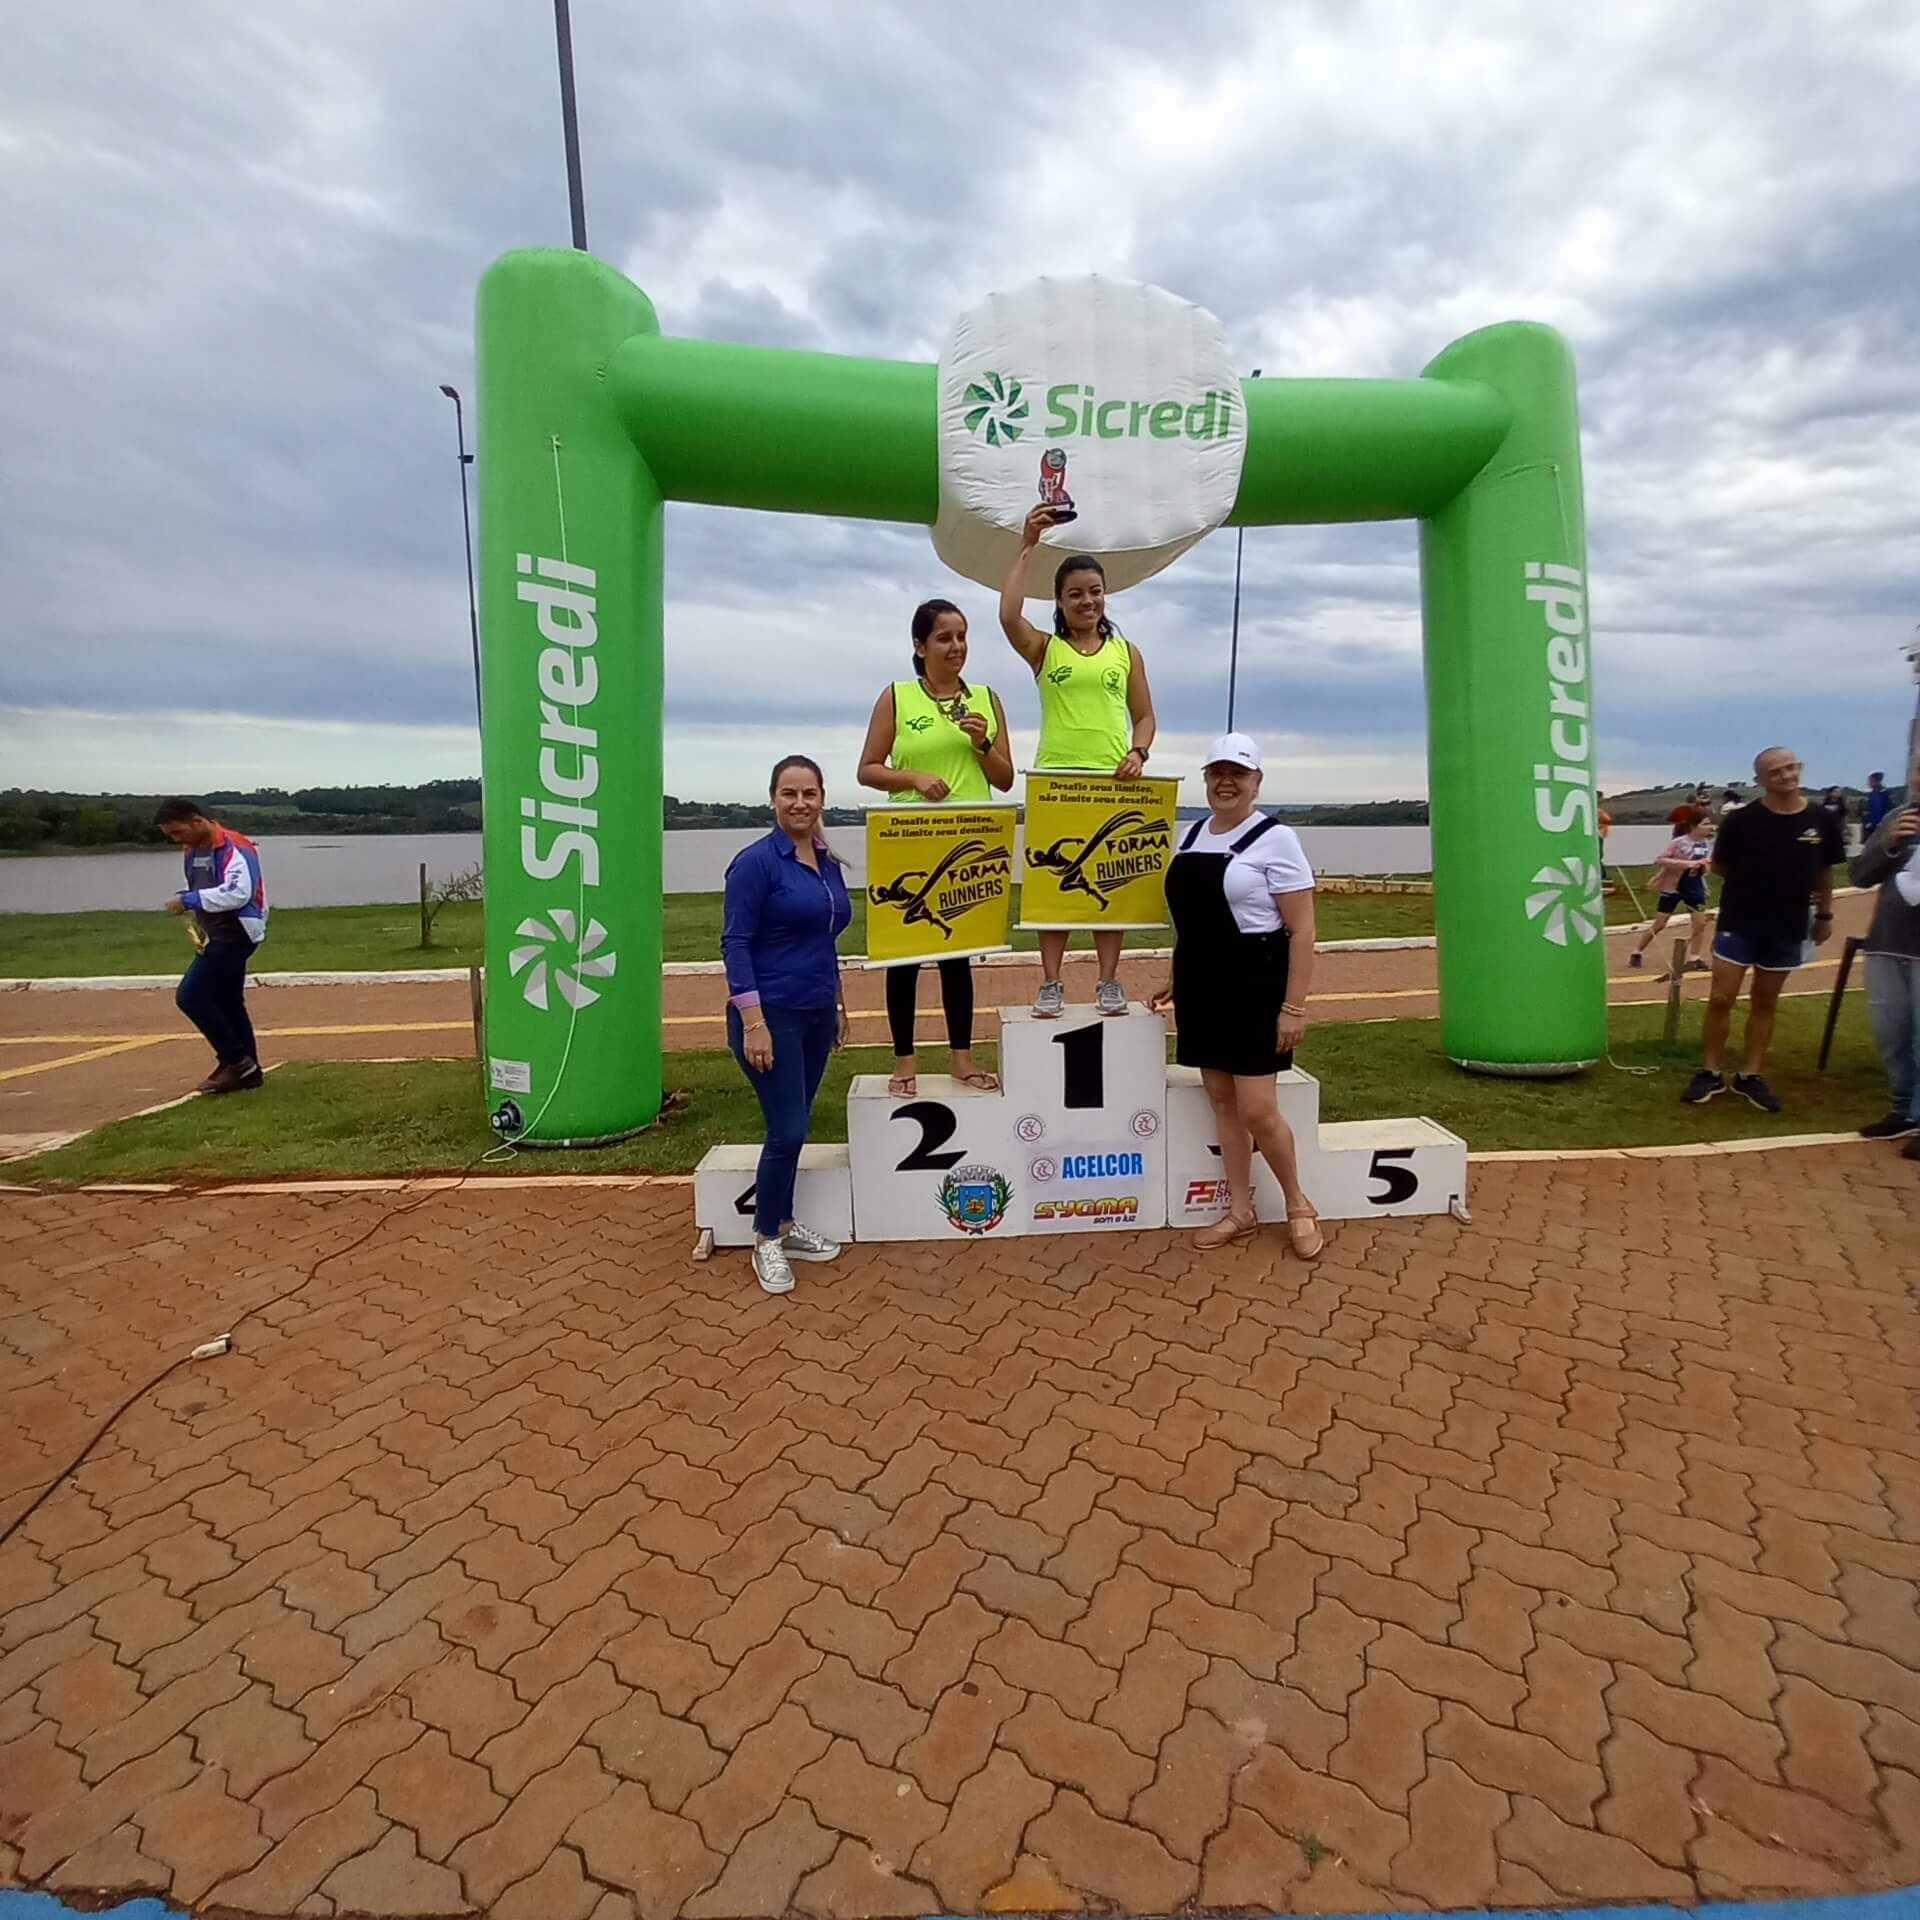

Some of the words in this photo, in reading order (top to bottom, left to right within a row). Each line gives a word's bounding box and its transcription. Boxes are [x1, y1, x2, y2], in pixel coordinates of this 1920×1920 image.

[1045, 384, 1232, 440] Sicredi
[1524, 561, 1594, 836] Sicredi
[516, 553, 600, 887] Sicredi
[1060, 794, 1091, 802] limite
[1093, 796, 1115, 804] seus
[1090, 784, 1112, 792] seus
[902, 829, 933, 837] limite
[932, 817, 954, 825] seus
[1105, 834, 1169, 856] FORMA
[947, 860, 1010, 885] FORMA
[1096, 853, 1162, 880] RUNNERS
[939, 879, 1003, 909] RUNNERS
[1052, 1021, 1104, 1109] 1
[889, 1101, 968, 1172] 2
[1062, 1153, 1142, 1179] ACELCOR
[1366, 1149, 1419, 1204] 5
[1123, 1214, 1136, 1222] luz
